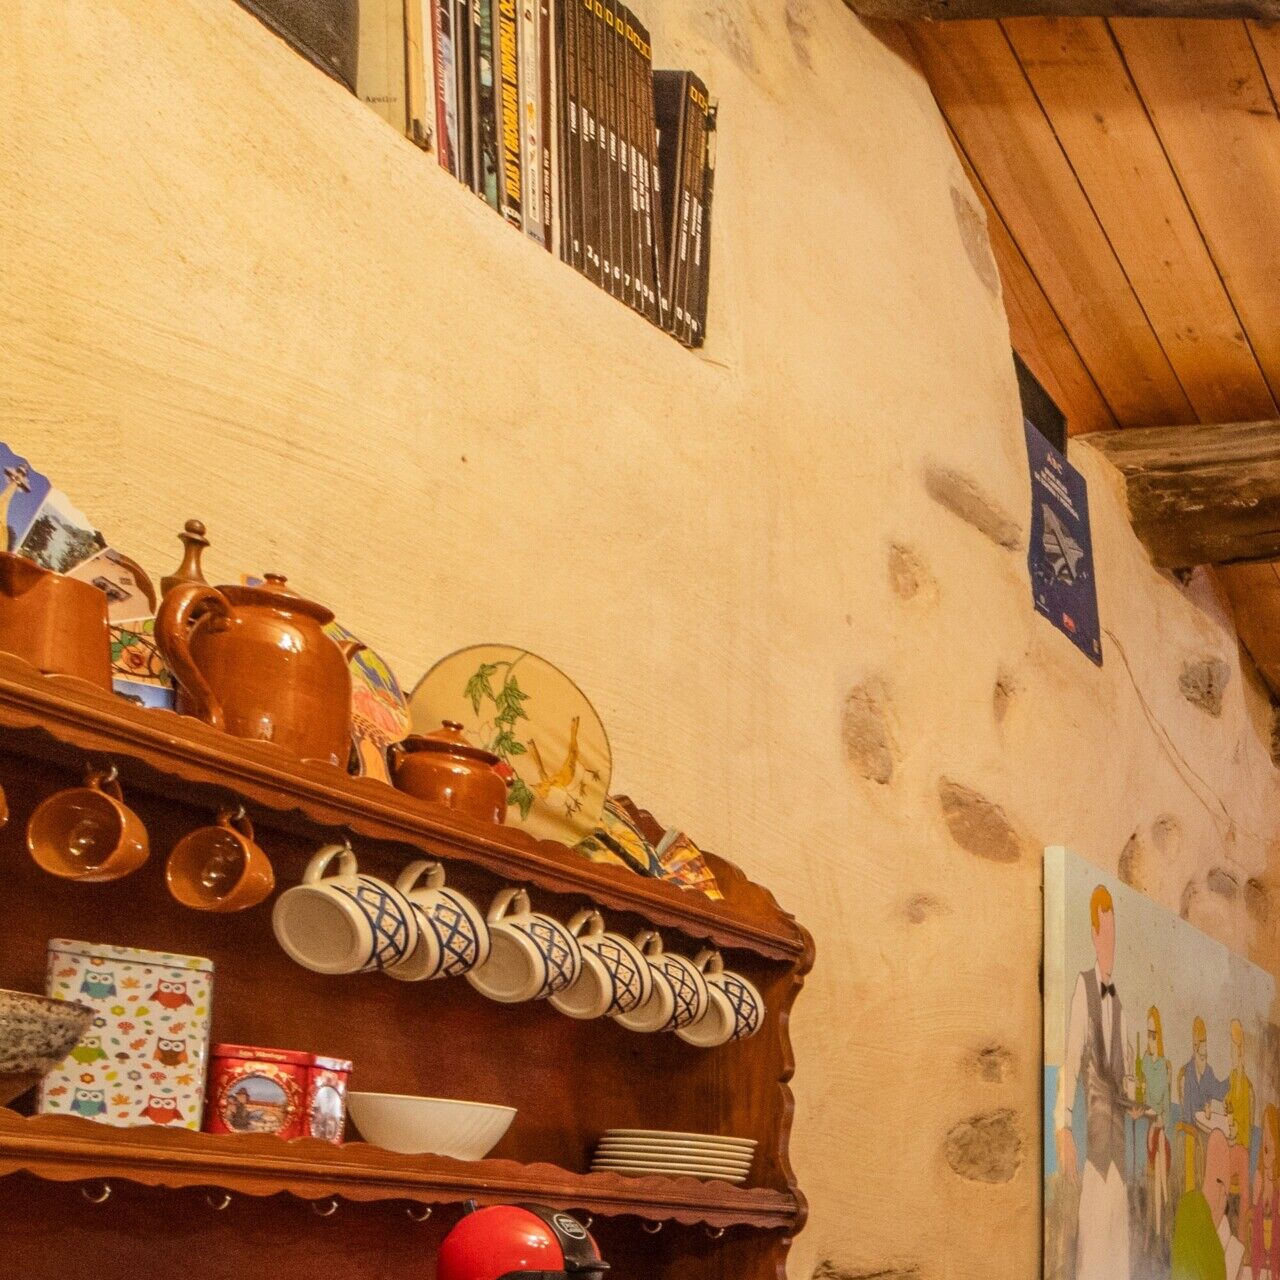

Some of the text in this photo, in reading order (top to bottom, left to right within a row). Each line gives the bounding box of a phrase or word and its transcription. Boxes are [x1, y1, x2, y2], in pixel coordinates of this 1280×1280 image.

[499, 18, 519, 85] UNIVERSAL
[505, 151, 519, 170] Y
[505, 172, 521, 202] ATLAS
